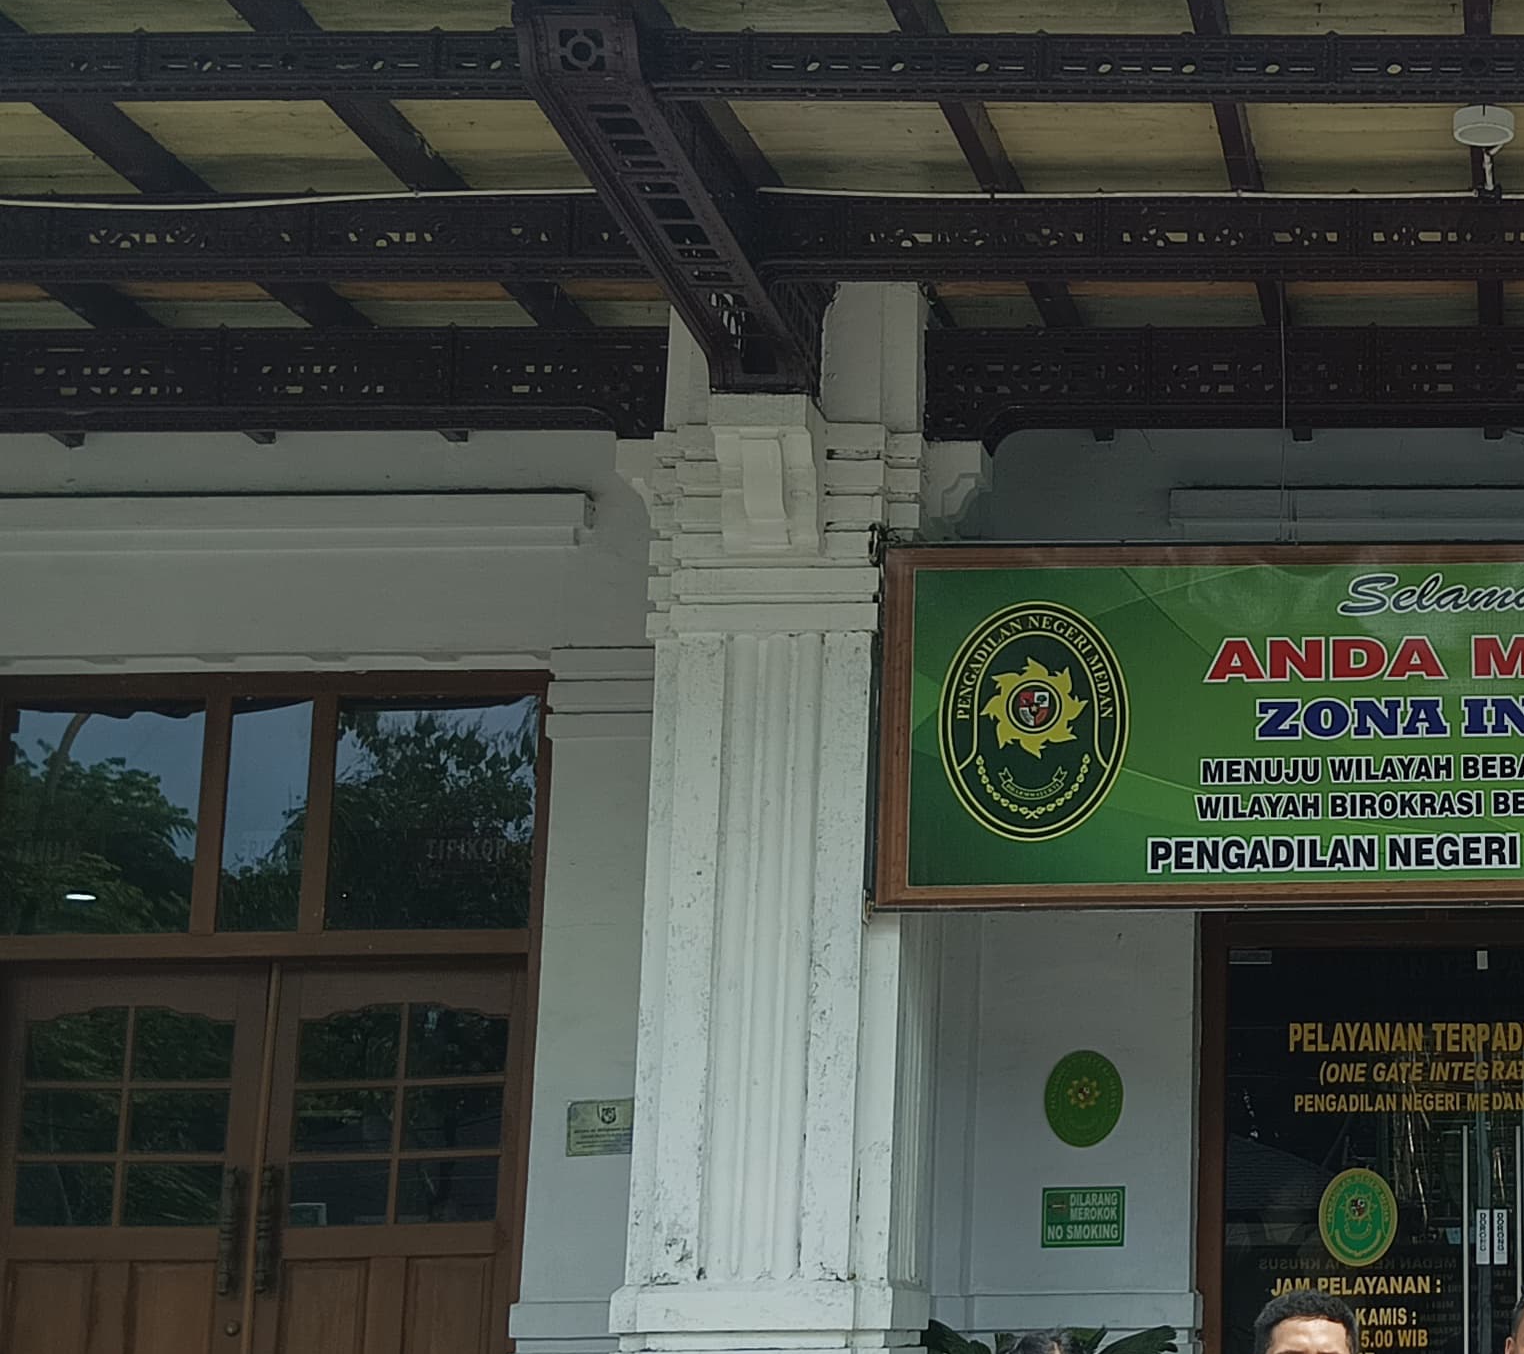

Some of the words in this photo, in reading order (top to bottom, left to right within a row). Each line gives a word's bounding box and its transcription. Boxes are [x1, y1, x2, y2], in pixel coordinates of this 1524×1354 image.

[957, 616, 1023, 720] PENGADILAN
[1027, 616, 1093, 657] NEGERI
[1086, 652, 1114, 719] MEDAN
[1203, 636, 1448, 683] ANDA
[1256, 696, 1450, 739] ZONA
[1200, 758, 1321, 785] MENUJU
[1328, 756, 1452, 783] WILAYAH
[1196, 793, 1321, 820] WILAYAH
[1329, 791, 1484, 819] BIROKRASI
[1147, 836, 1376, 873] PENGADILAN
[1386, 834, 1519, 870] NEGERI
[1289, 1023, 1423, 1052] PELAYANAN
[1320, 1061, 1367, 1085] (ONE
[1373, 1062, 1424, 1083] GATE
[1294, 1094, 1396, 1112] PENGADILAN
[1402, 1094, 1460, 1112] NEGERI
[1070, 1192, 1118, 1206] DILARANG
[1070, 1206, 1118, 1221] MEROKOK
[1047, 1224, 1063, 1240] NO
[1066, 1224, 1118, 1239] SMOKING
[1318, 1276, 1431, 1295] PELAYANAN
[1355, 1307, 1407, 1326] KAMIS
[1398, 1329, 1429, 1347] WIB
